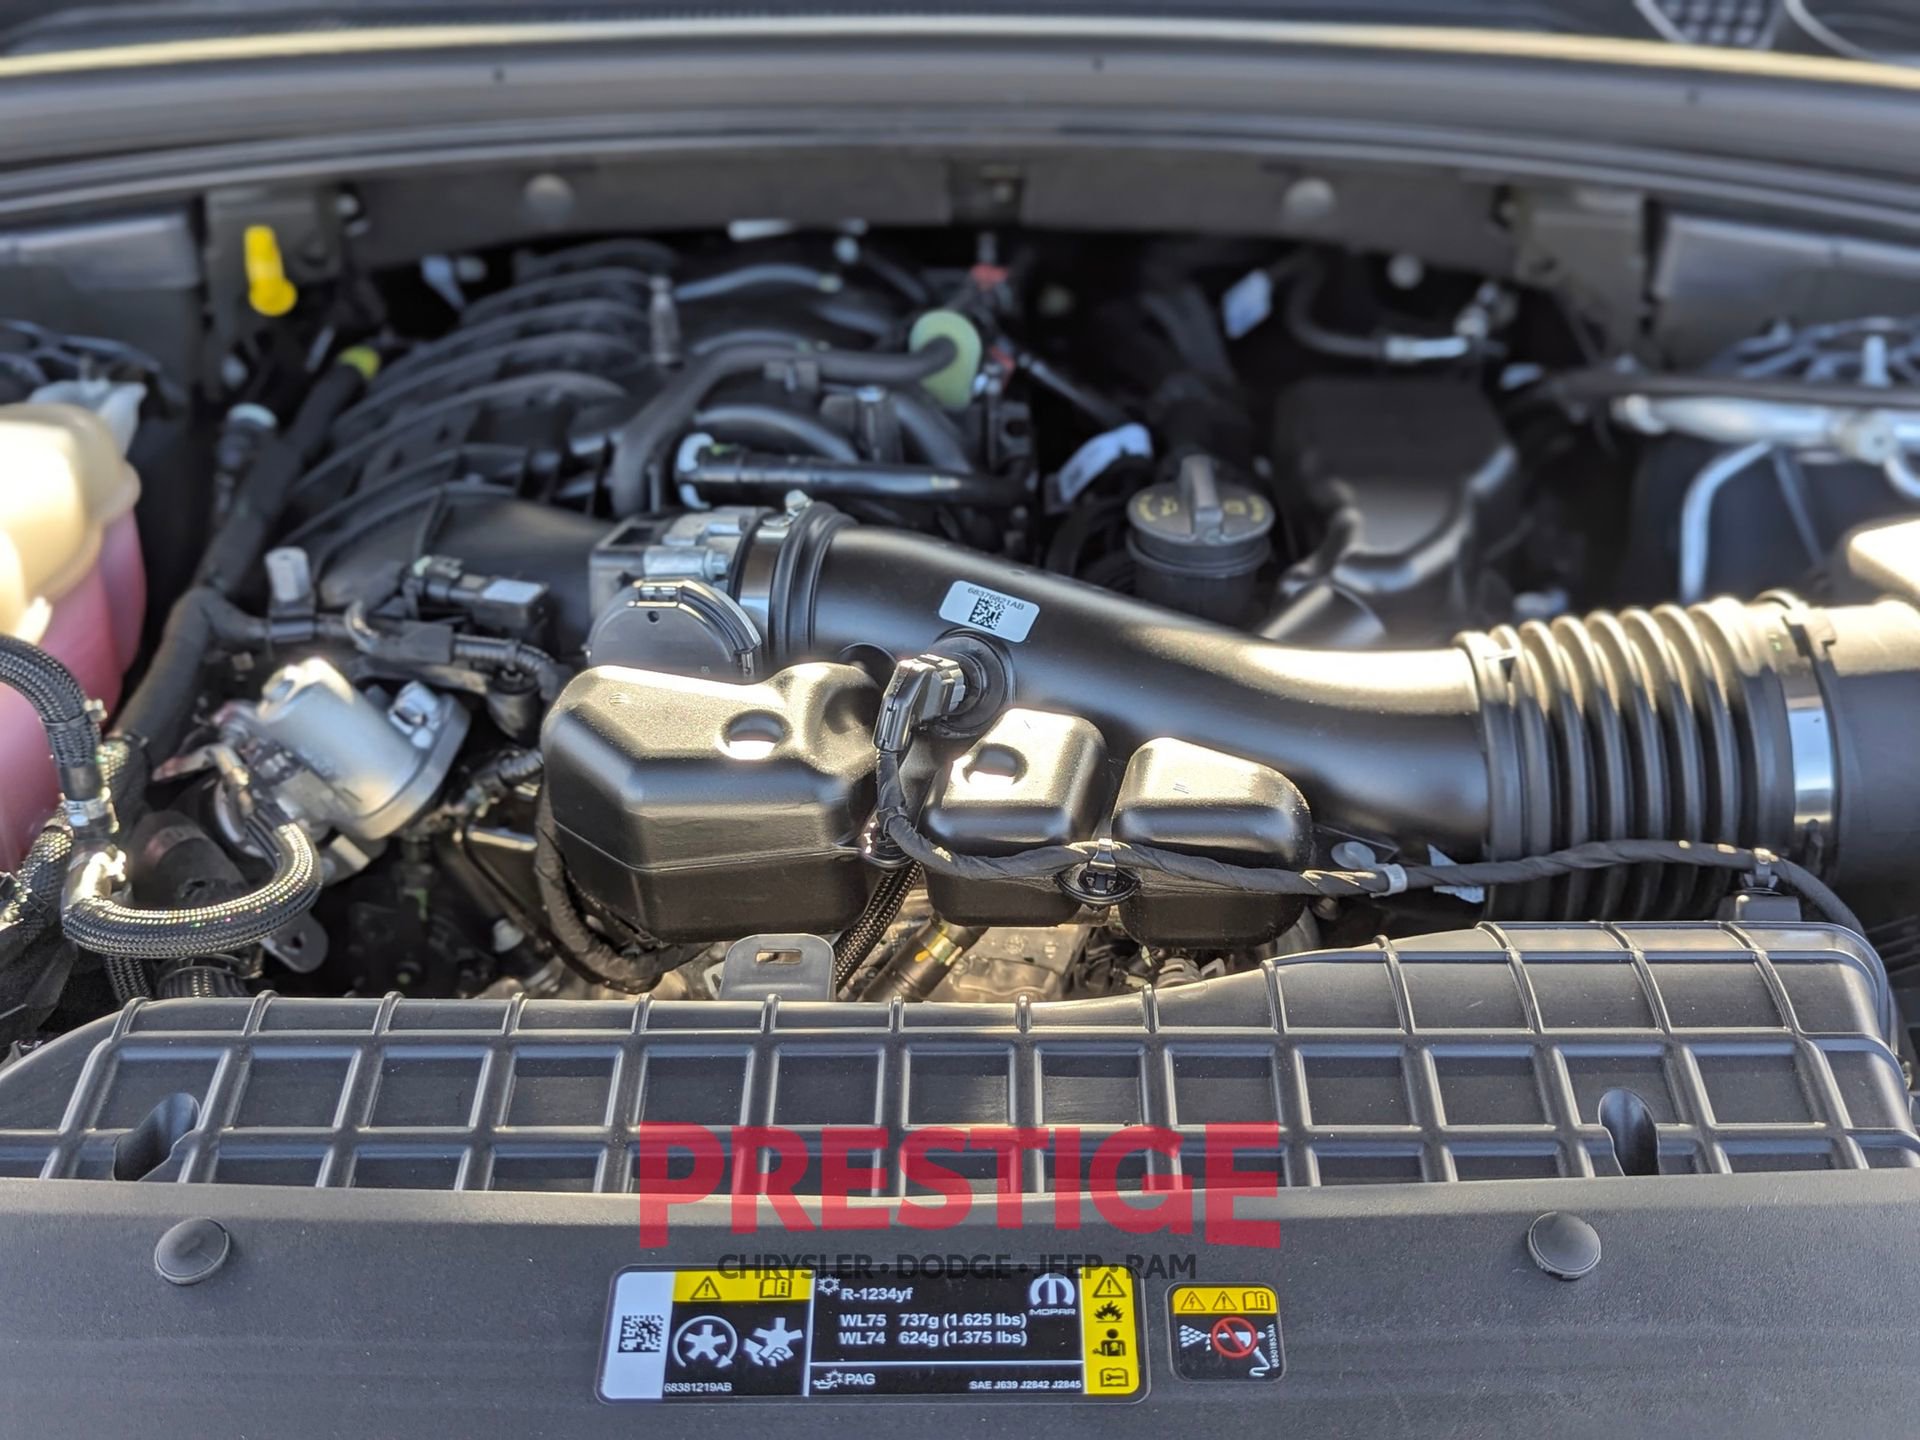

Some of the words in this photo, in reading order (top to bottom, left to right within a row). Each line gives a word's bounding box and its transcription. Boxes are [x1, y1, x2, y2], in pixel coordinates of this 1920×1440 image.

[840, 1287, 914, 1303] R-1234yf
[1029, 1308, 1076, 1316] MOPAR
[839, 1313, 887, 1327] WL75
[898, 1313, 939, 1329] 737g
[943, 1313, 992, 1329] (1.625
[995, 1313, 1027, 1329] lbs)
[839, 1331, 887, 1345] WL74
[898, 1331, 939, 1347] 624g
[943, 1331, 992, 1347] (1.375
[995, 1331, 1028, 1347] lbs)
[843, 1373, 876, 1385] PAG
[969, 1380, 993, 1389] SAE
[994, 1380, 1018, 1389] J639
[1019, 1380, 1050, 1389] J2842
[1052, 1380, 1082, 1389] J2845
